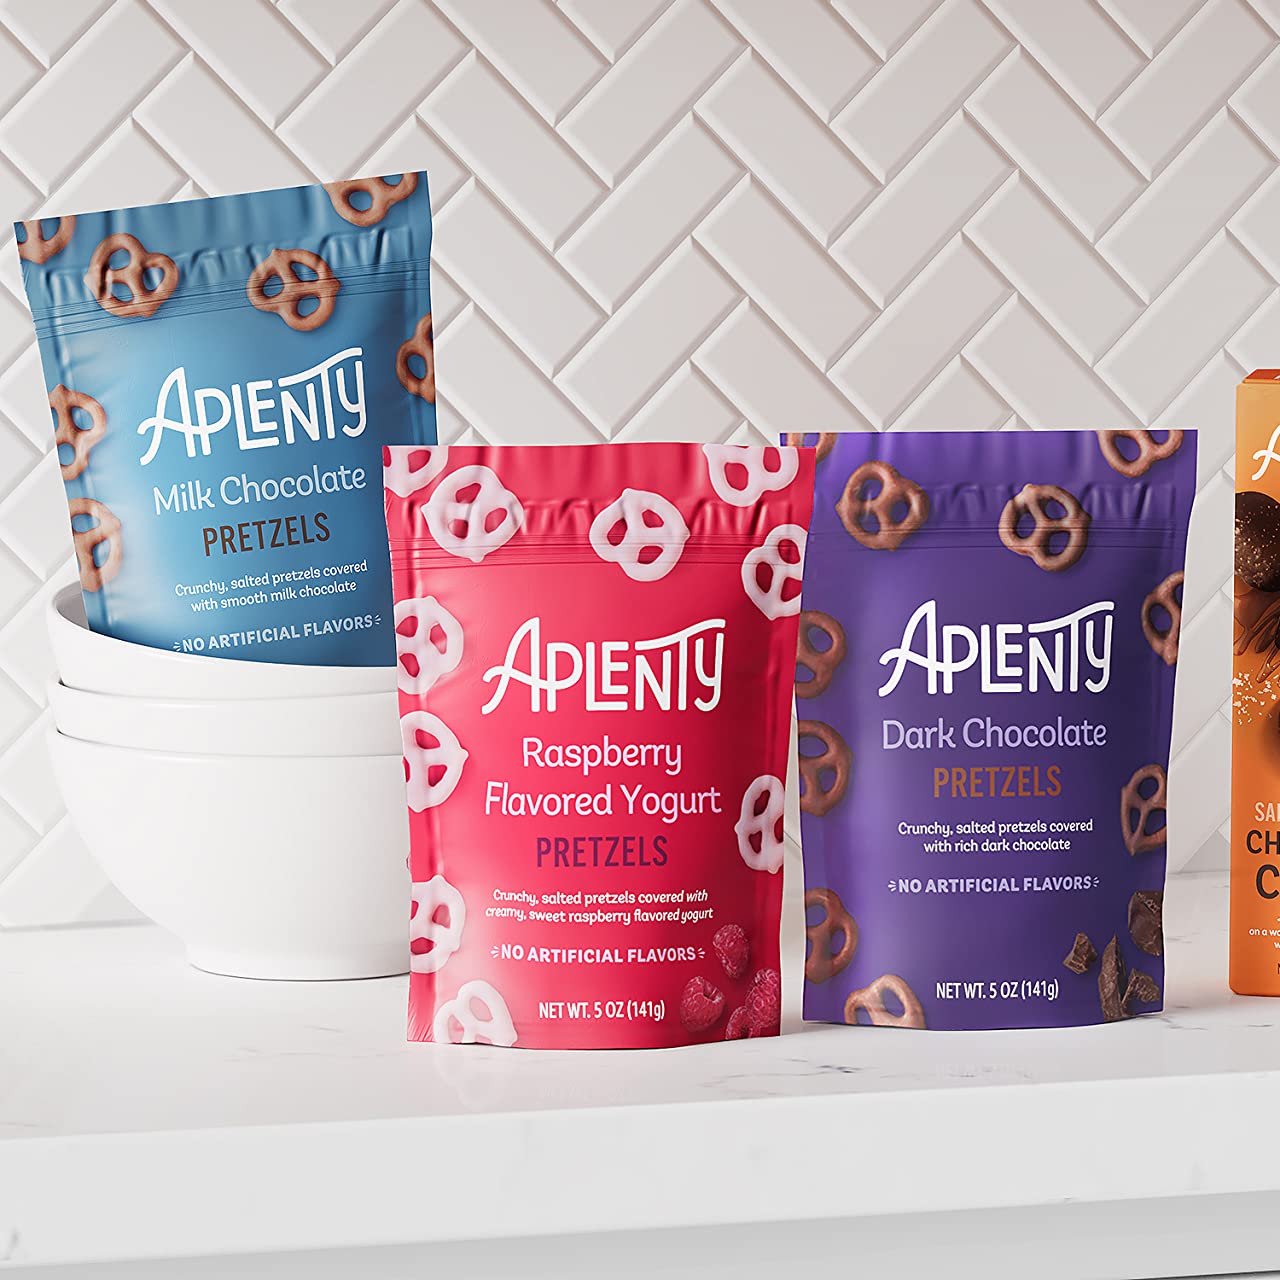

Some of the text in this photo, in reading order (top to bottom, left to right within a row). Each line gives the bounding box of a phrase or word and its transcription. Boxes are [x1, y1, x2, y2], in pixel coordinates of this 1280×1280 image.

[138, 348, 367, 465] APLENTY
[154, 465, 366, 514] Milk Chocolate
[203, 513, 330, 556] PRETZELS
[191, 581, 356, 612] with smooth milk chocolate
[182, 614, 373, 652] NO ARTIFICIAL FLAVORS
[879, 600, 1114, 696] APLENTY
[482, 617, 725, 714] APLENTY
[883, 717, 1106, 749] Dark Chocolate
[524, 736, 681, 775] Raspberry
[934, 766, 1061, 797] PRETZELS
[486, 782, 721, 823] Flavored Yogurt
[537, 836, 667, 867] PRETZELS
[924, 838, 1070, 852] with rich dark chocolate
[899, 876, 1091, 892] NO ARTIFICIAL FLAVORS
[540, 1000, 664, 1021] NET WT. 5 OZ (141g)
